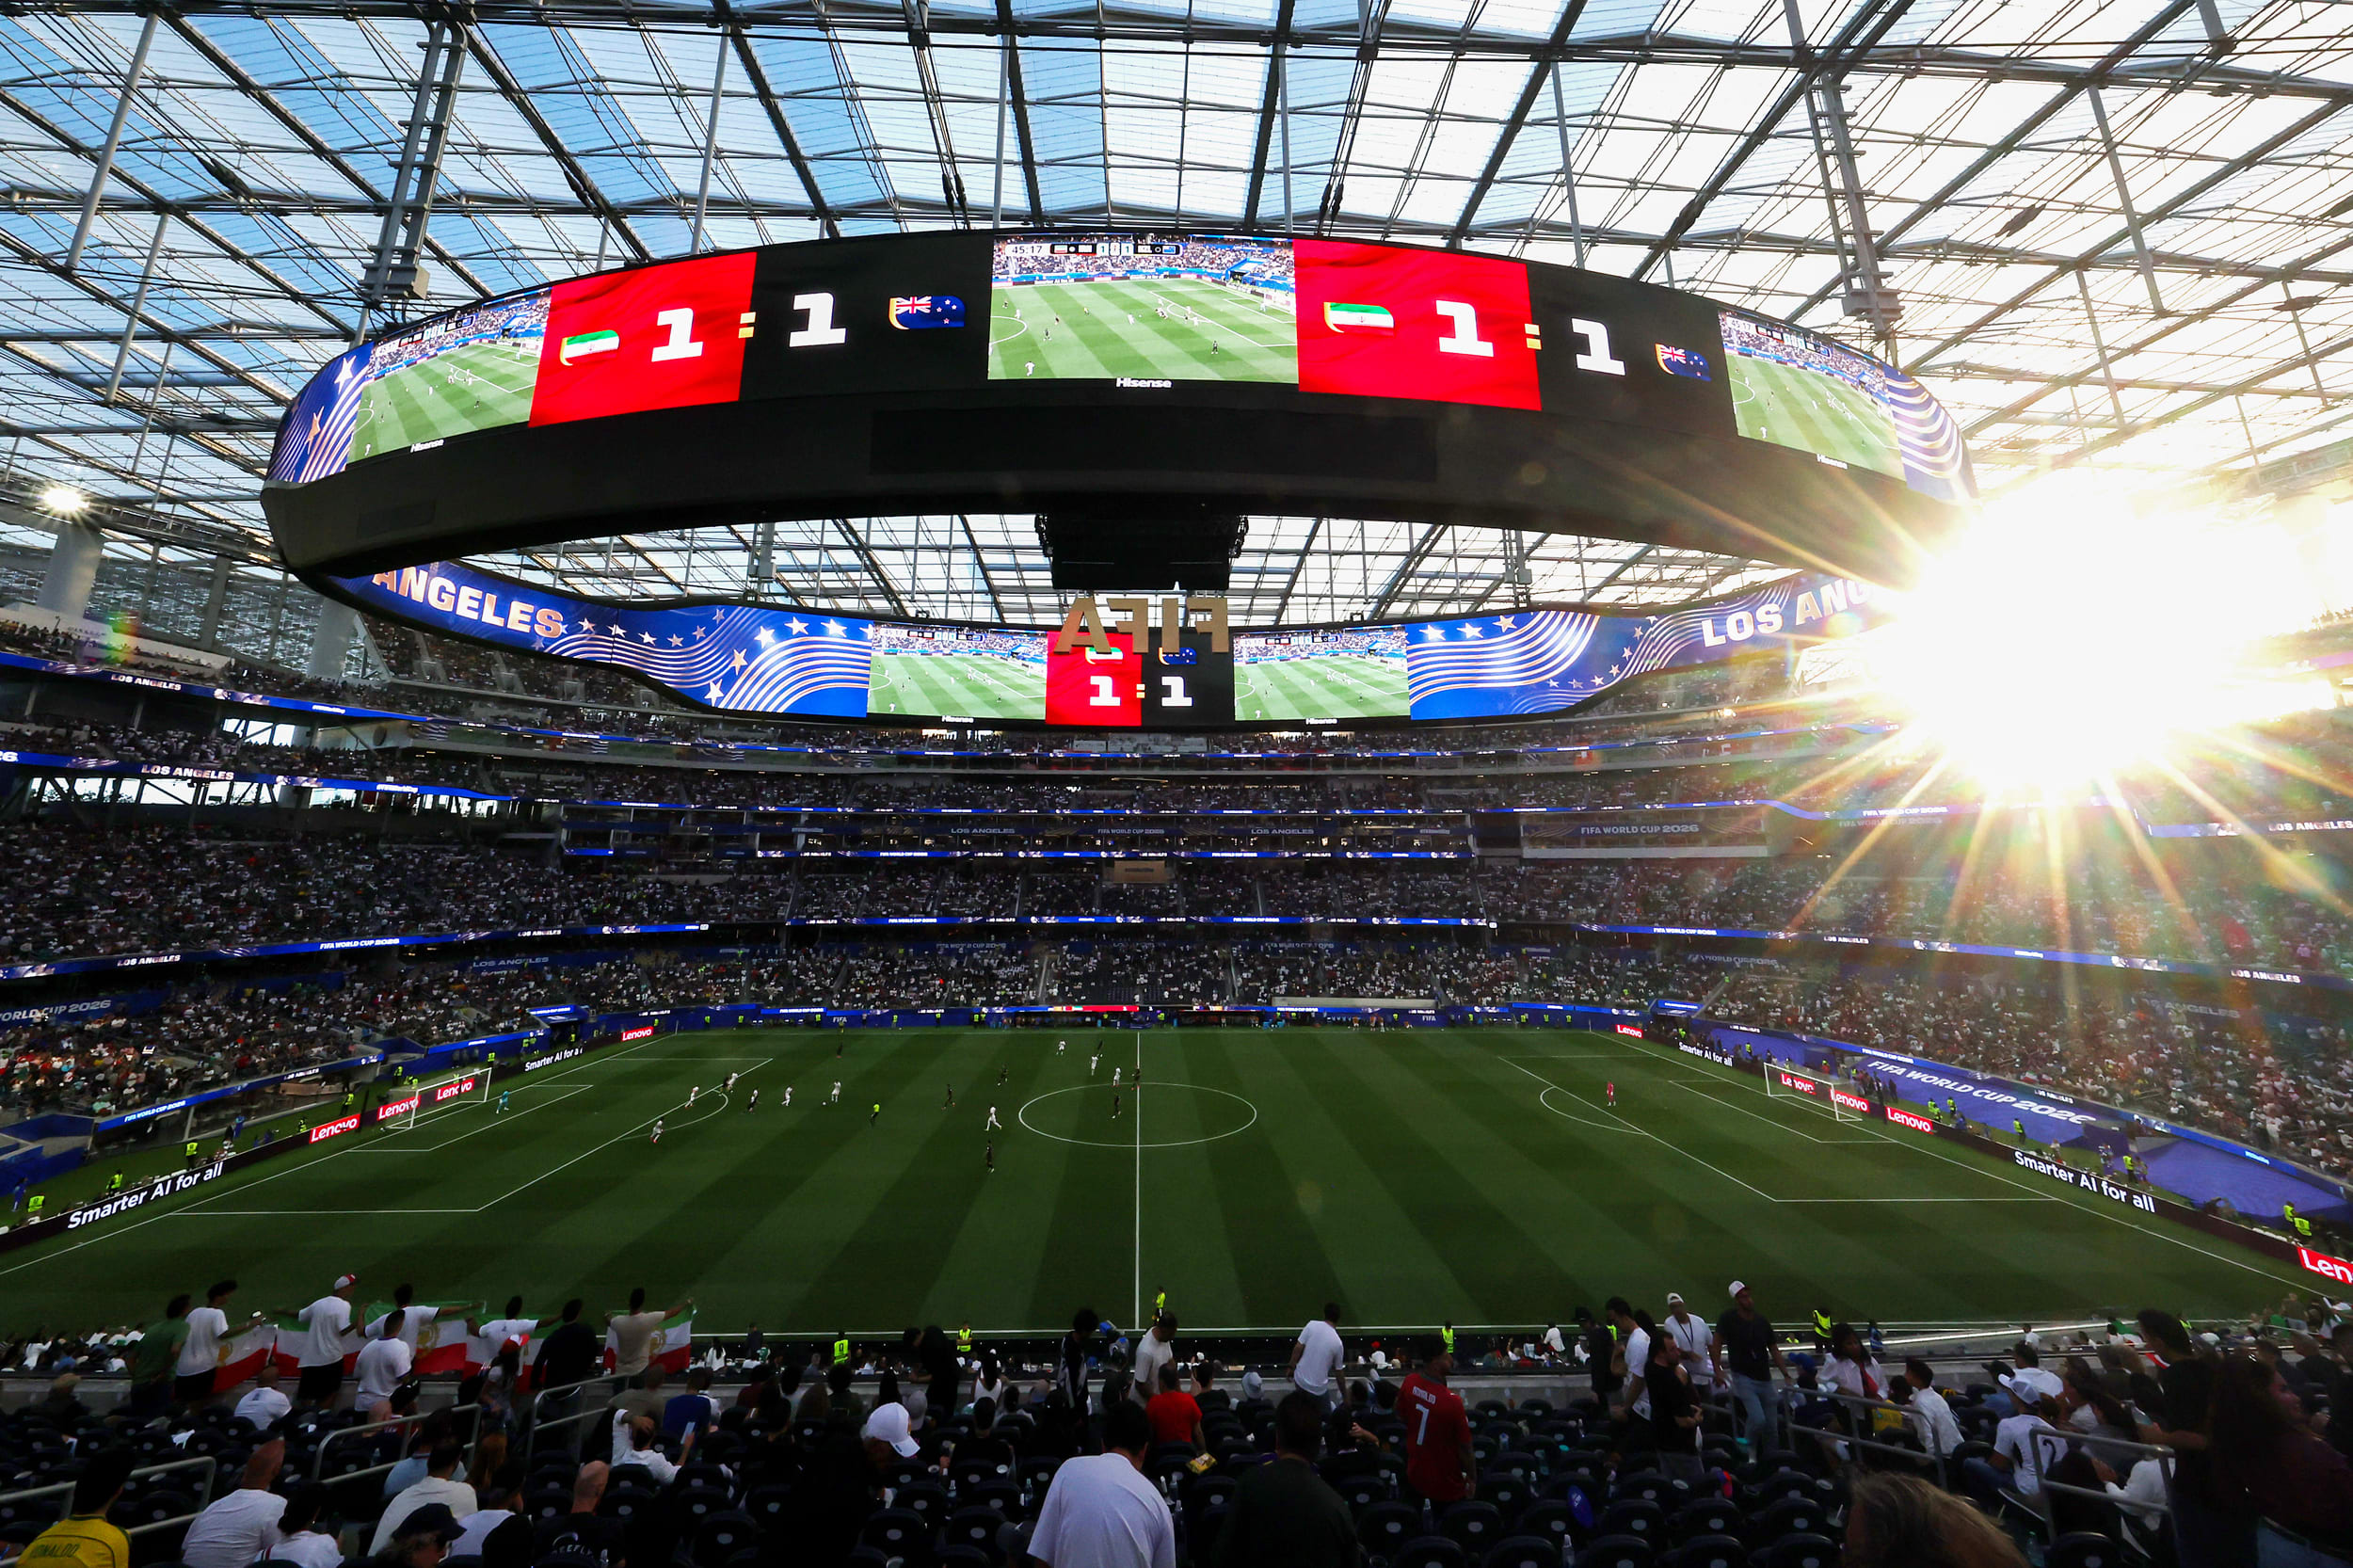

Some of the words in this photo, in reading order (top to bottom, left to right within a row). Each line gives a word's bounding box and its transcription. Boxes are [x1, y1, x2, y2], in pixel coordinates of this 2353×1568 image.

[1012, 246, 1042, 254] 45:17
[651, 308, 703, 362] 1
[789, 292, 846, 347] 1
[1436, 300, 1494, 357] 1
[1572, 318, 1625, 376] 1
[1115, 376, 1172, 389] Hisense
[371, 566, 564, 638] ANGELES
[1701, 602, 1784, 648] LOS
[1796, 578, 1872, 626] ANG
[111, 674, 133, 683] LOS
[135, 677, 182, 691] ANGELES
[1090, 676, 1121, 706] 1
[1161, 676, 1193, 706] 1
[141, 764, 170, 776] LOS
[172, 766, 234, 780] ANGELES
[1603, 826, 1638, 835] WORLD
[1641, 825, 1661, 834] CUP
[1662, 824, 1700, 833] 2026
[118, 958, 137, 967] LOS
[138, 954, 181, 965] ANGELES
[2231, 970, 2251, 979] LOS
[2252, 971, 2301, 984] ANGELES
[0, 1008, 42, 1022] ORLD
[68, 1000, 112, 1014] 2026
[622, 1029, 652, 1041] Lenovo
[1617, 1024, 1642, 1038] Lenovo
[524, 1054, 553, 1071] Smarter
[553, 1051, 563, 1062] AI
[563, 1048, 574, 1059] for
[1678, 1041, 1704, 1057] Smarter
[1704, 1050, 1712, 1060] AI
[1713, 1052, 1722, 1064] for
[1723, 1055, 1733, 1066] all
[1867, 1060, 1904, 1077] FIFA
[1905, 1070, 1975, 1094] WORLD
[1973, 1088, 2019, 1105] CUP
[310, 1116, 358, 1143] Lenovo
[1886, 1106, 1930, 1133] Lenovo
[68, 1189, 147, 1229] Smarter
[151, 1180, 172, 1202] AI
[175, 1171, 200, 1192] for
[202, 1161, 224, 1179] all
[2014, 1151, 2074, 1184] Smarter
[2079, 1175, 2098, 1193] AI
[2102, 1180, 2127, 1203] for
[2132, 1193, 2155, 1213] all
[2301, 1249, 2353, 1284] Len
[1416, 1403, 1429, 1446] 7
